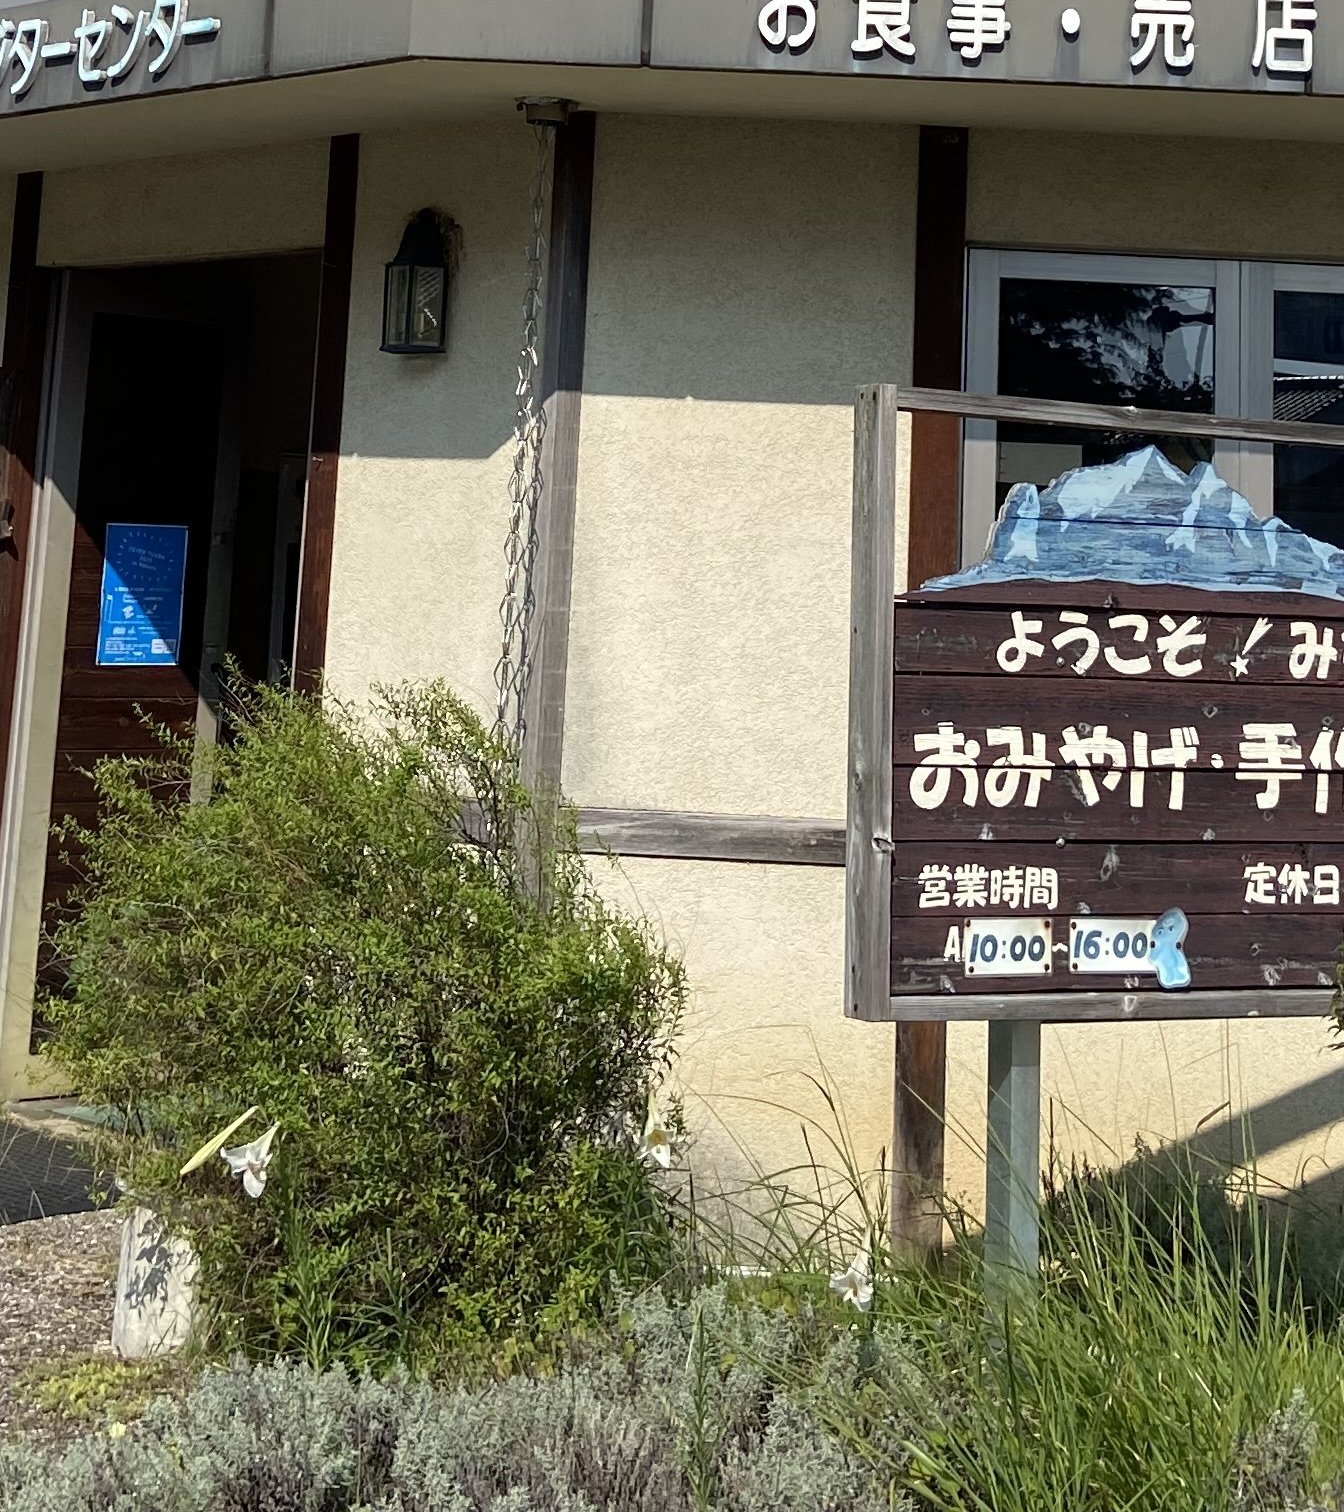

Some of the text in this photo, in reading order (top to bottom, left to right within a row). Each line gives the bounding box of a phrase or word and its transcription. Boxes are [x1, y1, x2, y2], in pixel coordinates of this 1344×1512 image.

[918, 863, 1059, 910] 営業時間
[1243, 864, 1341, 906] 定休日
[943, 926, 965, 963] A
